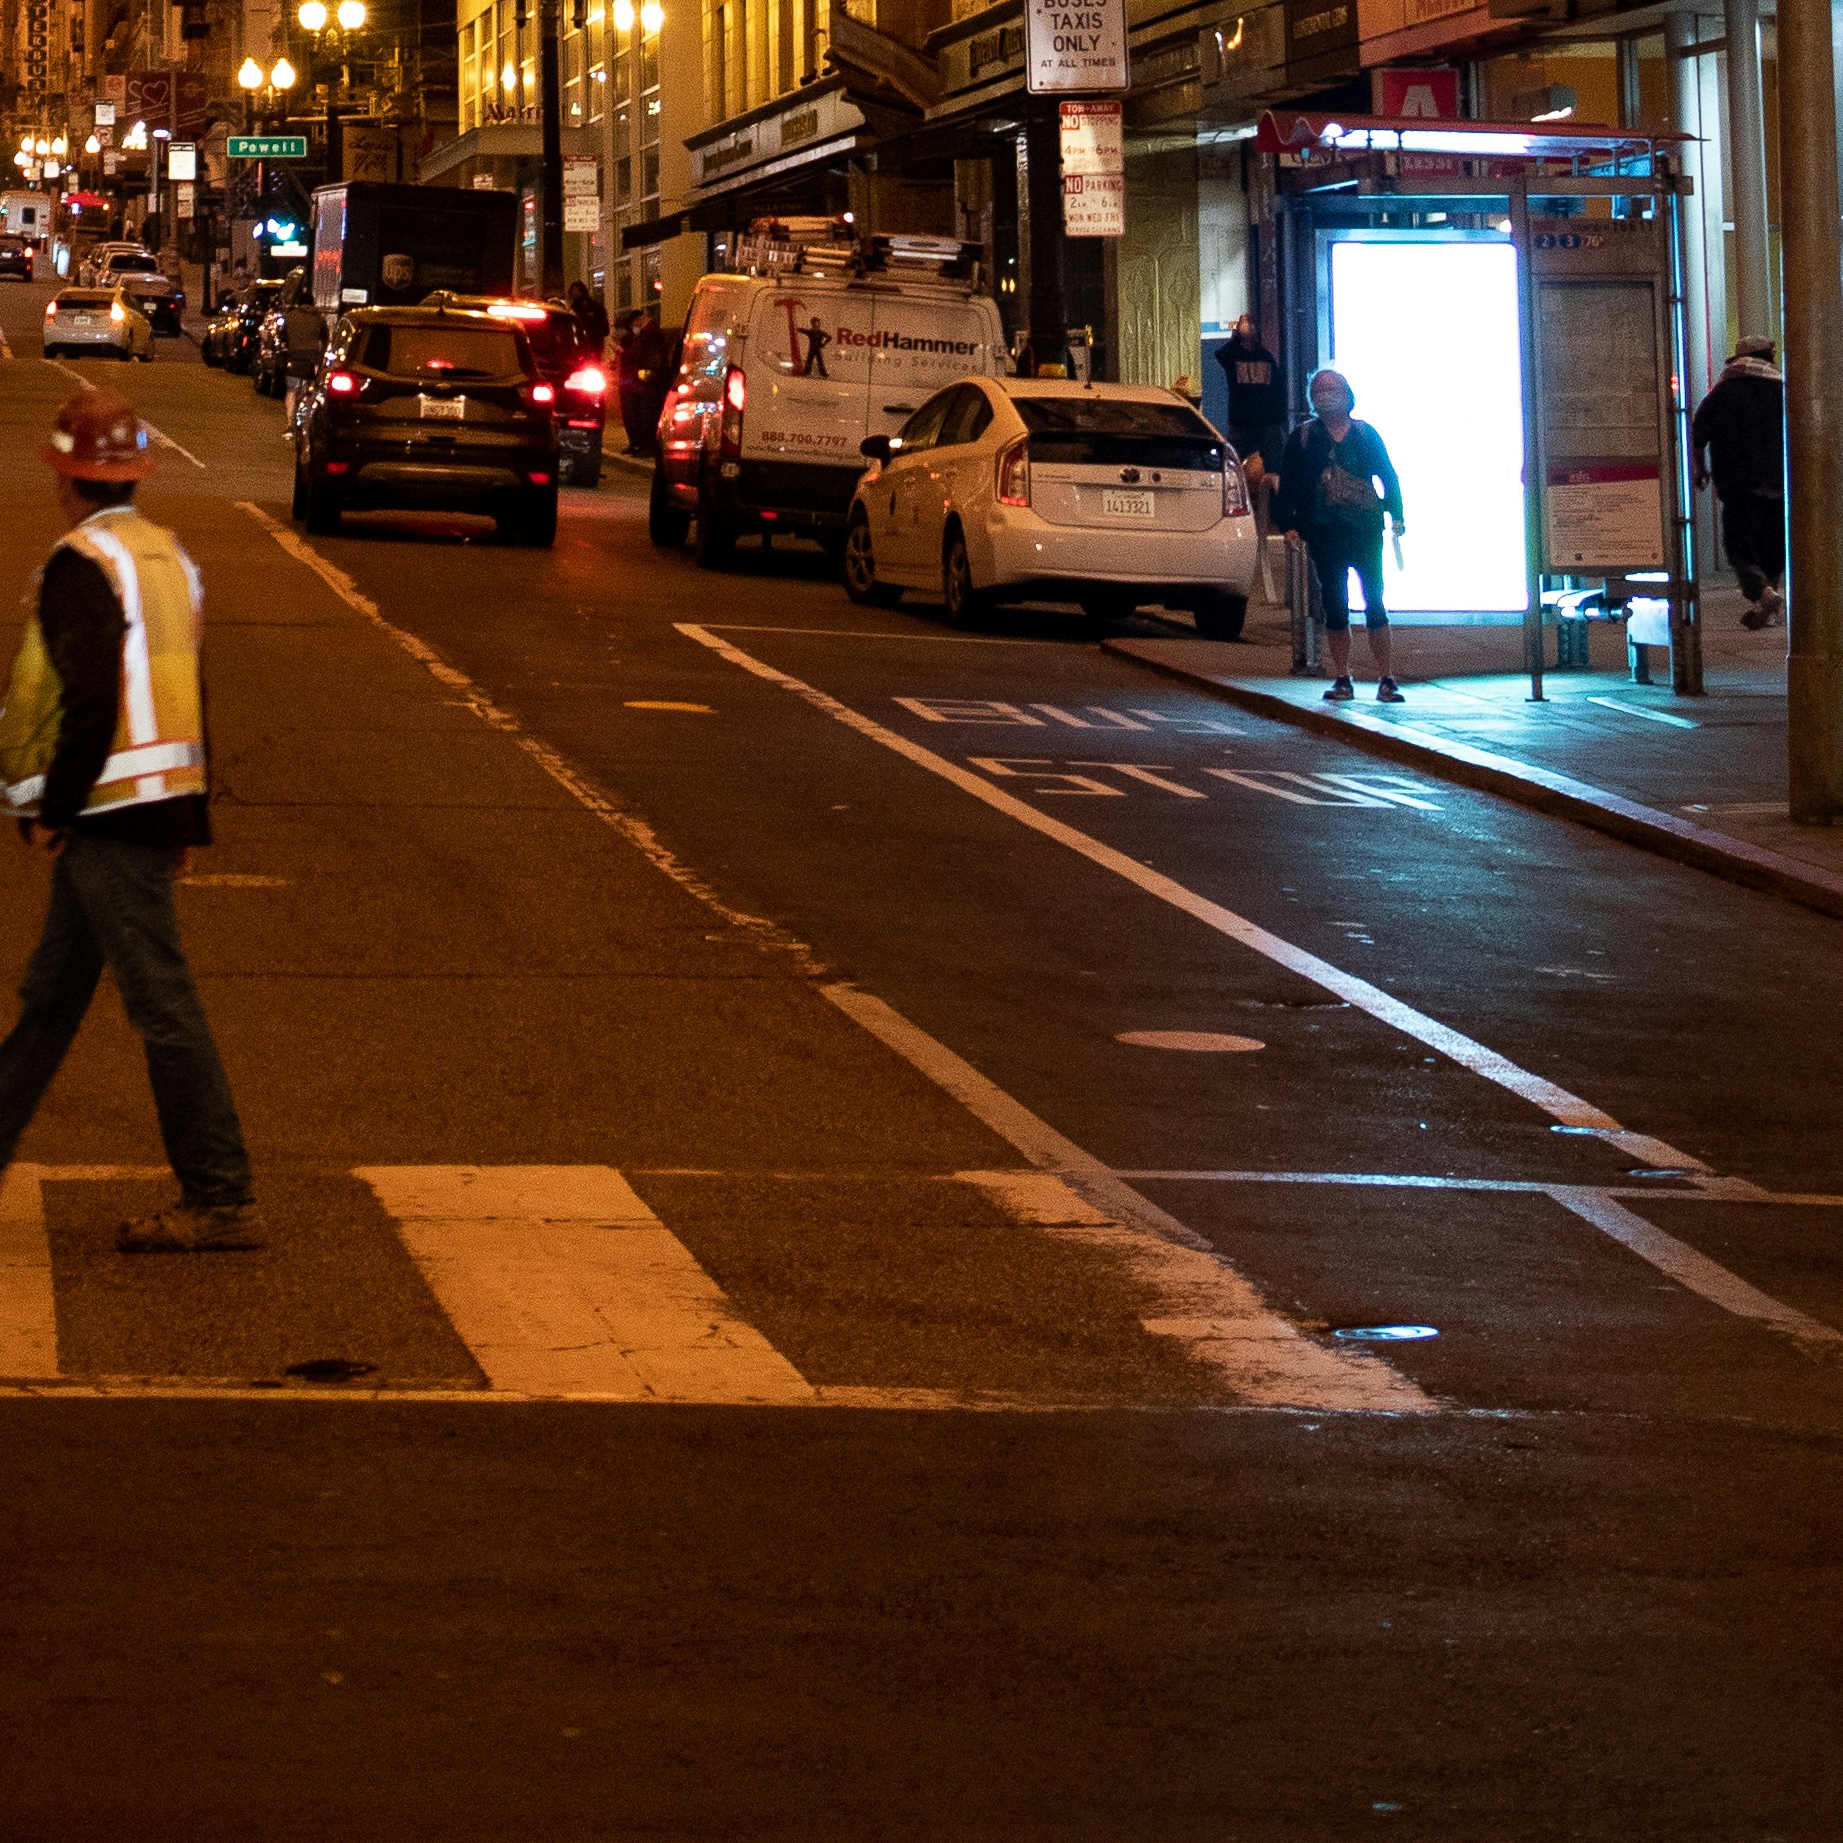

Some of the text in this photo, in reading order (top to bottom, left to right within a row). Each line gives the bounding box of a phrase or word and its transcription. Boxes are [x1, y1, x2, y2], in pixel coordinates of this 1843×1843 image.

[1050, 12, 1104, 31] TAXIS
[1052, 34, 1102, 53] ONLY
[1040, 57, 1116, 68] AT ALL TIMES
[1067, 104, 1115, 114] TOW-AWAY
[1063, 115, 1079, 128] NO
[238, 141, 296, 153] Powell
[1066, 176, 1122, 193] NO PARKING
[836, 326, 979, 356] RedHammer
[891, 696, 1248, 736] BUS
[967, 756, 1446, 812] STOP
